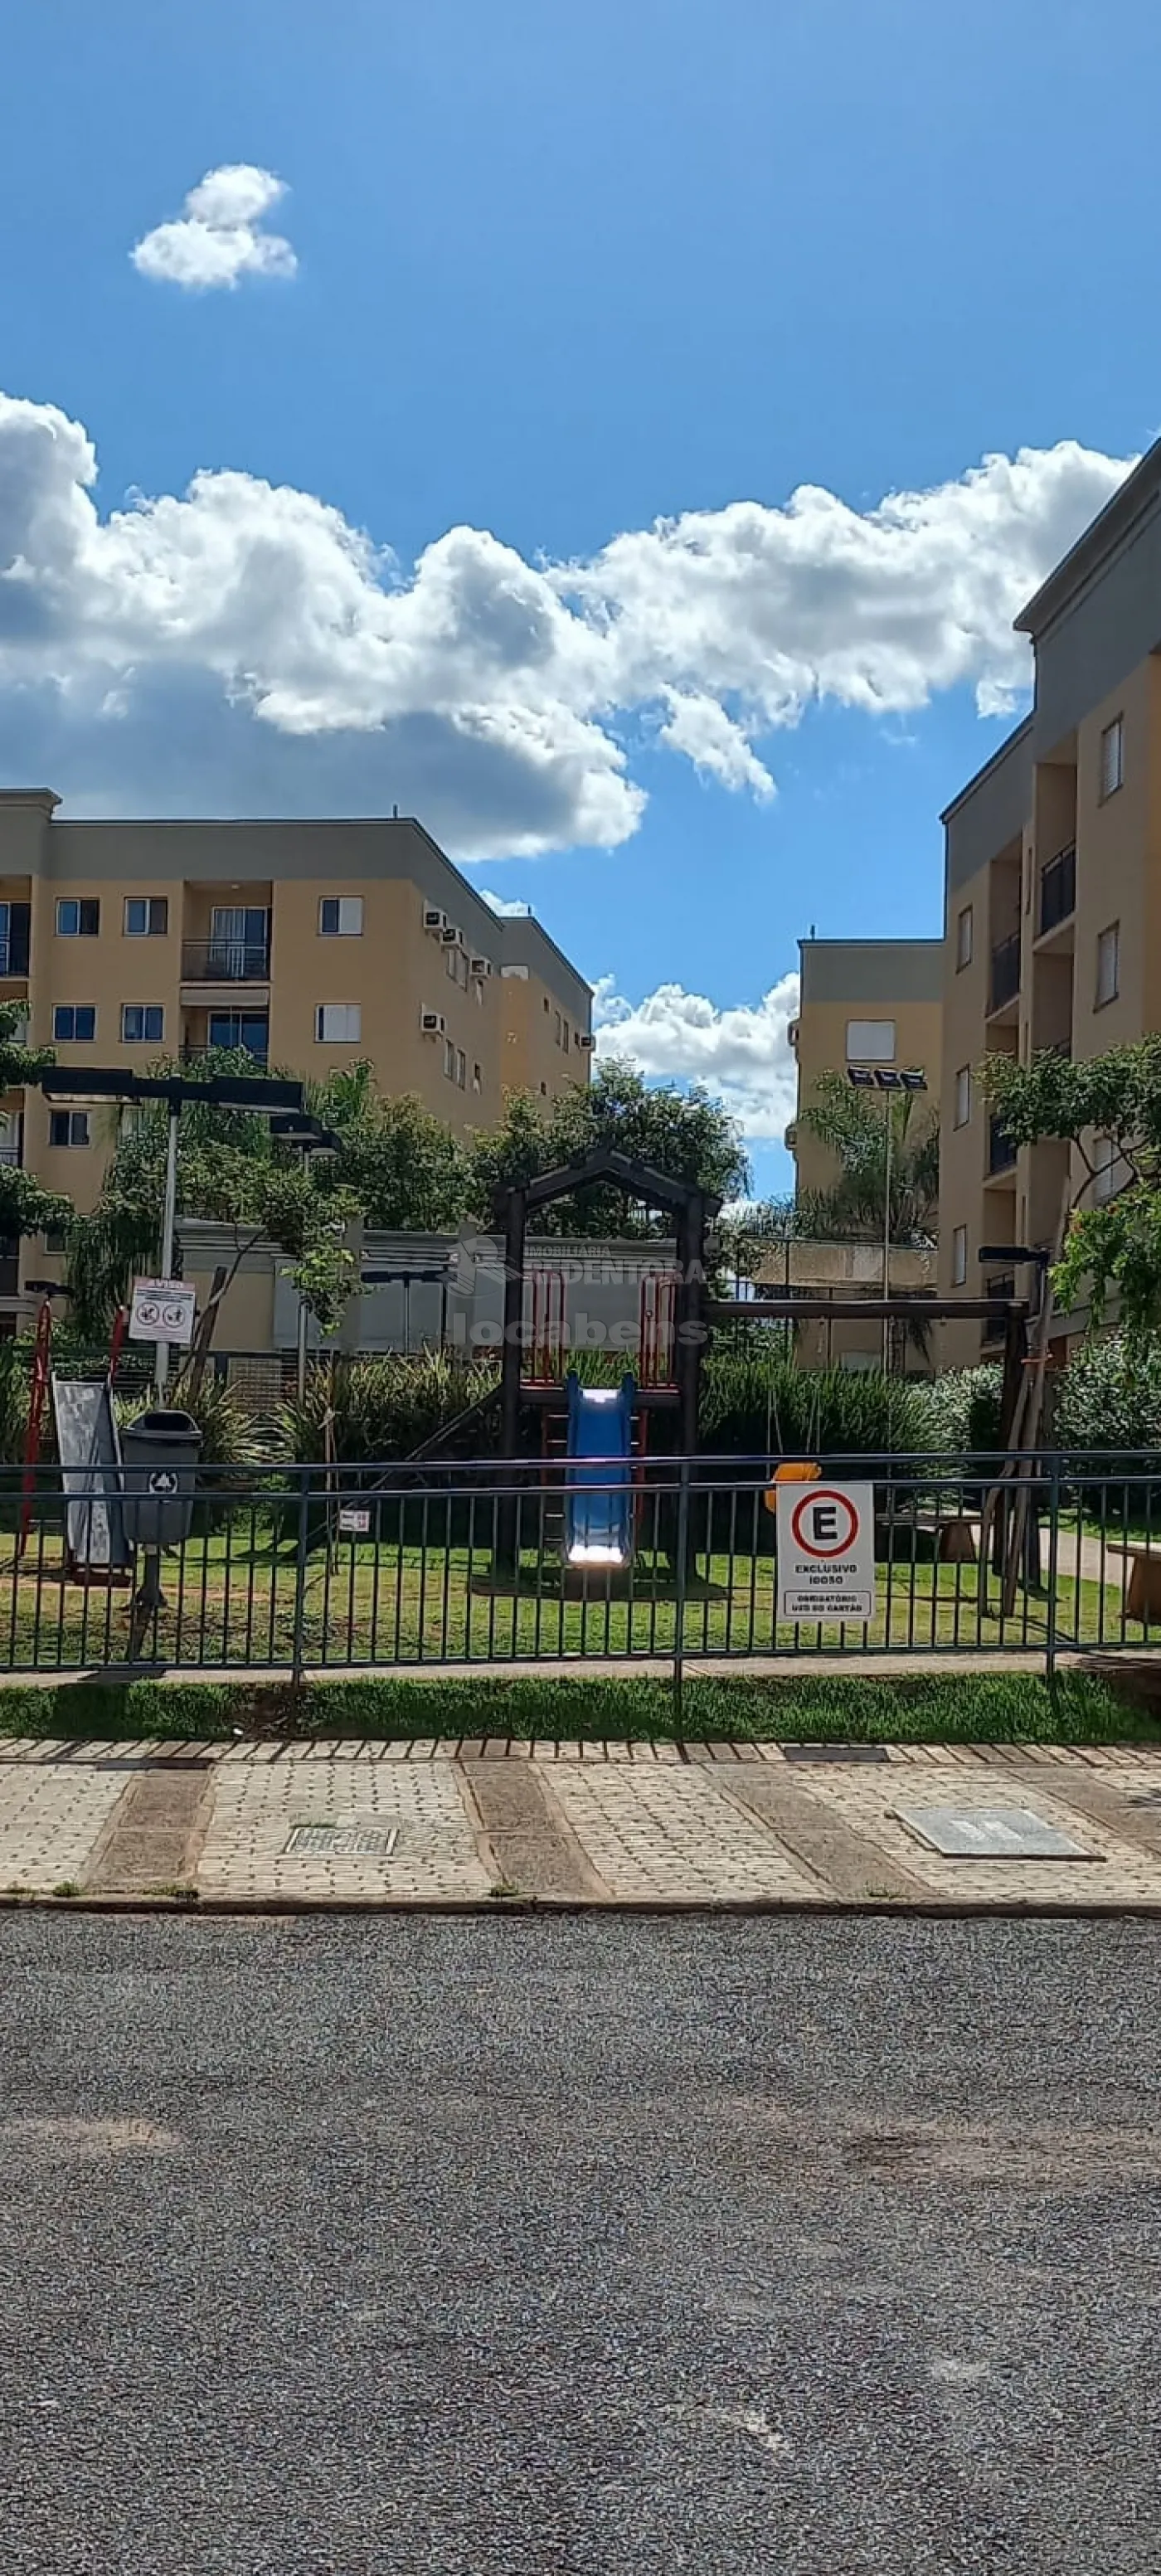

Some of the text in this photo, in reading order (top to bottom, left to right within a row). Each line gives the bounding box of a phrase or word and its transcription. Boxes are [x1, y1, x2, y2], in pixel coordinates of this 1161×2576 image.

[813, 1506, 838, 1540] E
[795, 1564, 857, 1573] EXCLUSIVO
[809, 1576, 843, 1585] IDOSO
